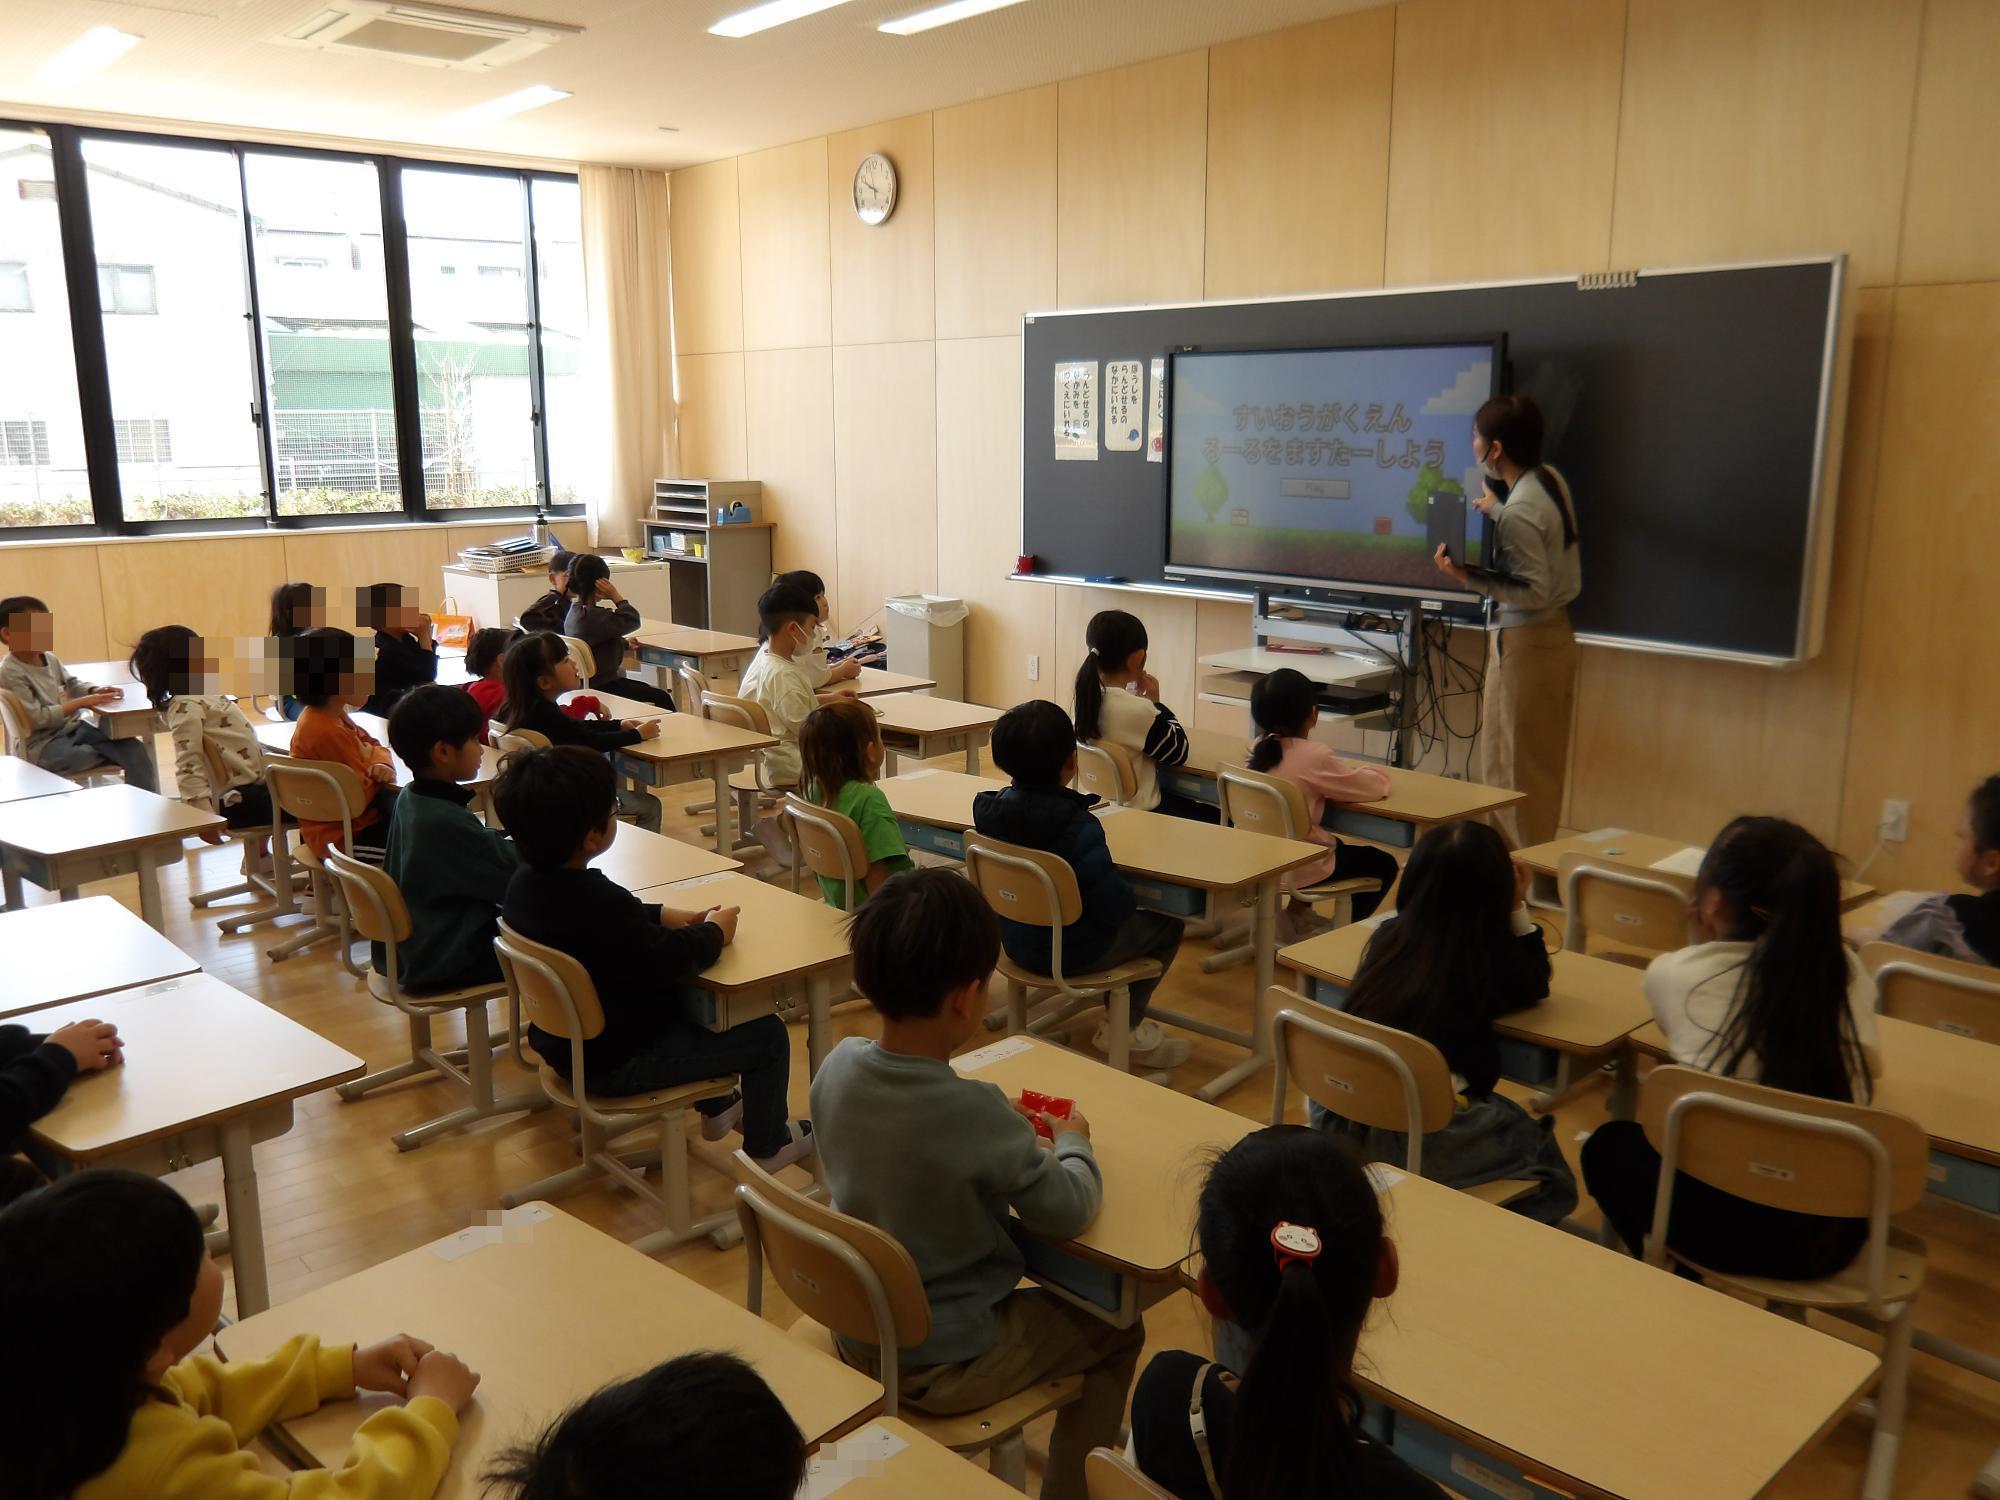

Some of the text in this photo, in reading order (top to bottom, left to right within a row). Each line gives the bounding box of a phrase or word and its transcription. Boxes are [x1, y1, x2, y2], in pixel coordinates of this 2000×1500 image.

[1232, 402, 1413, 433] すいおうがくえん
